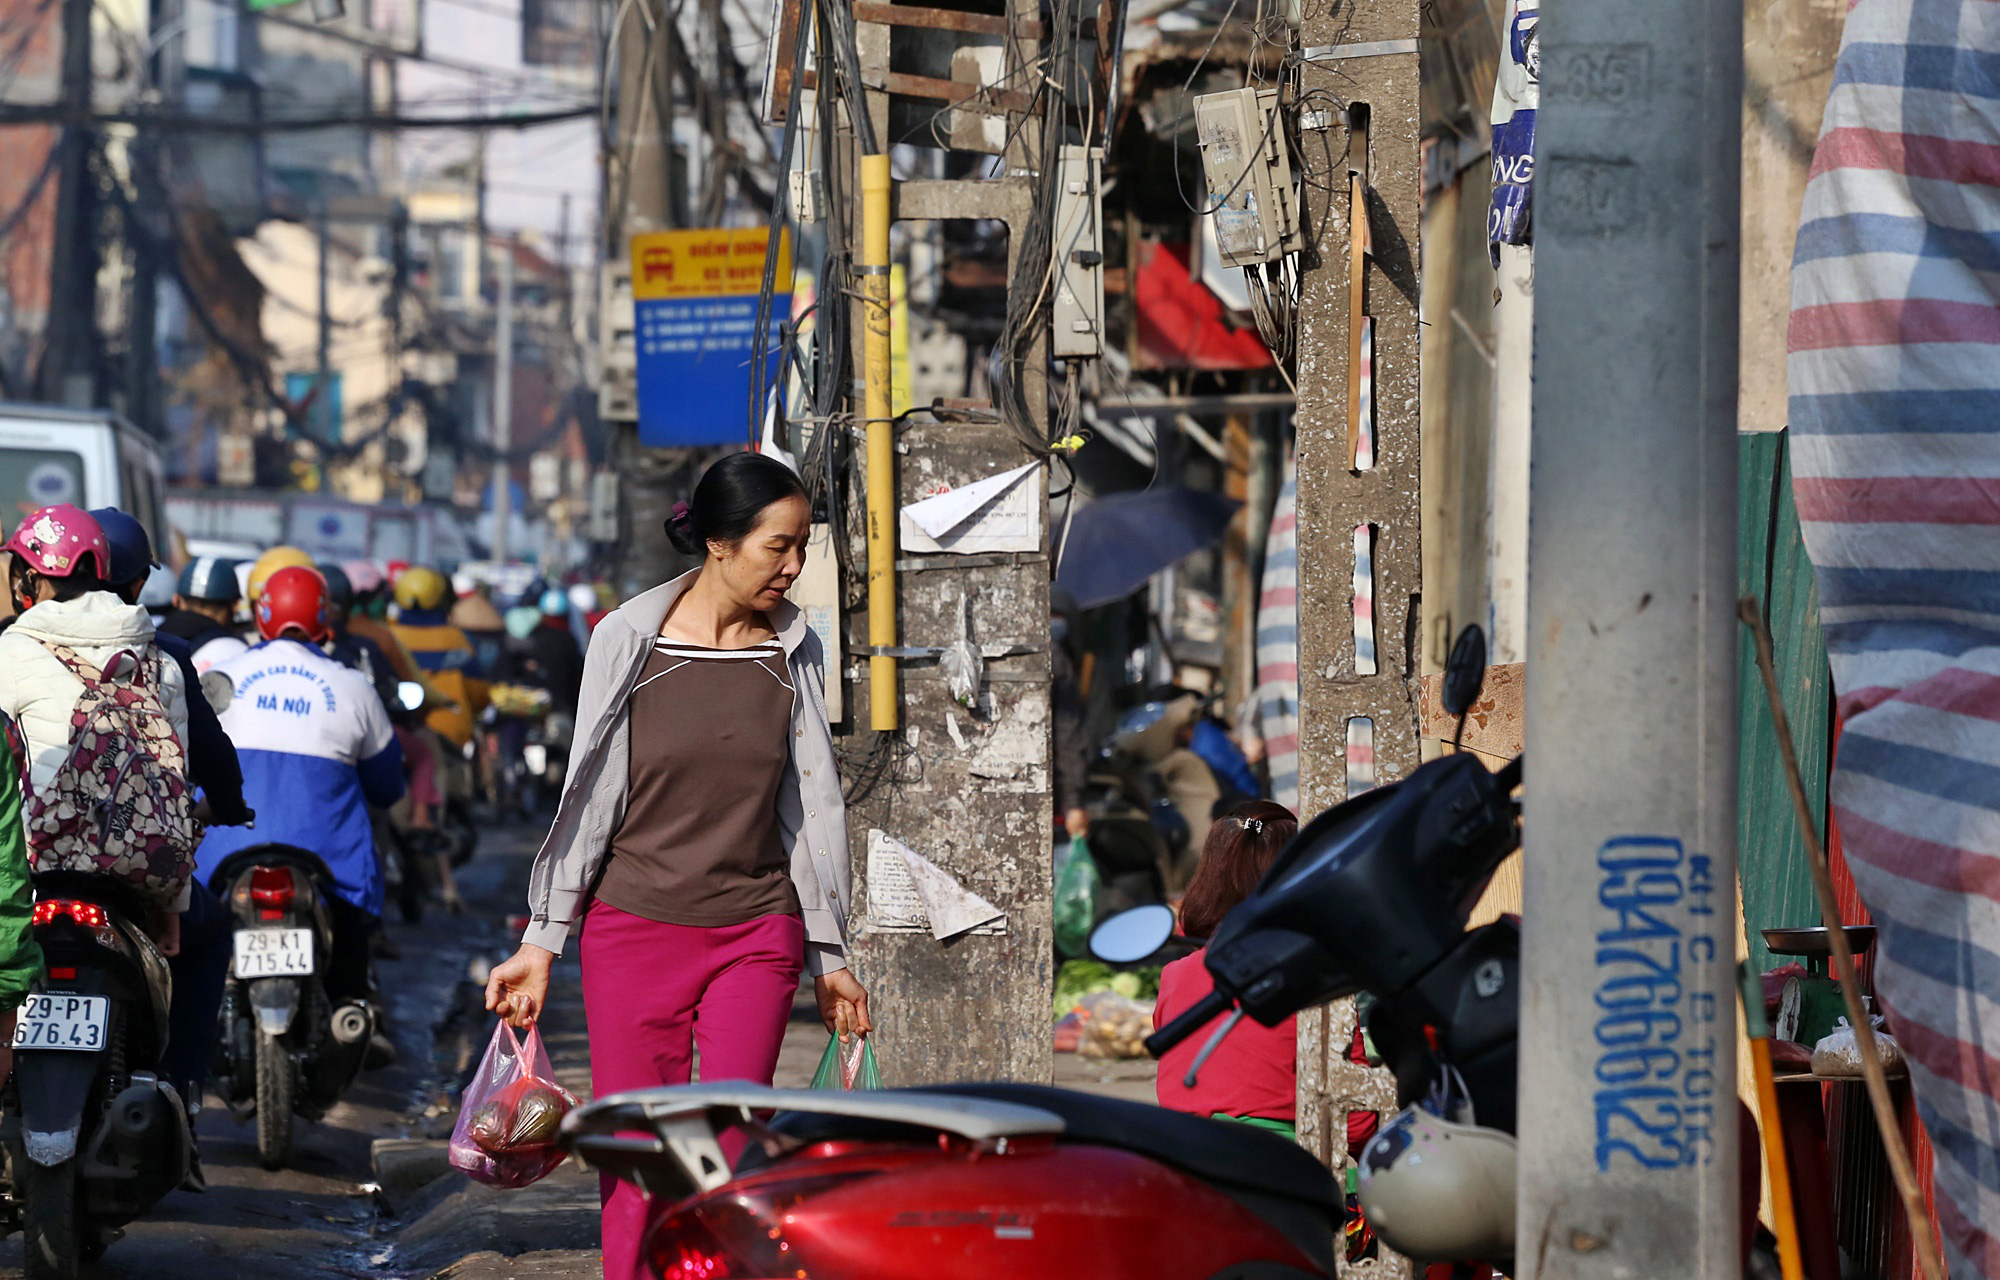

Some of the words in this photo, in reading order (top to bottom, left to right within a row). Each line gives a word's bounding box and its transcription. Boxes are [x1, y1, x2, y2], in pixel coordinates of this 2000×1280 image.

[256, 692, 277, 710] HÀ
[283, 696, 311, 717] NỘI
[248, 932, 299, 951] 29-K1
[241, 953, 306, 973] 715.44
[25, 997, 92, 1020] 29-P1
[1593, 835, 1684, 1174] 0947666122
[15, 1022, 99, 1046] 676.43
